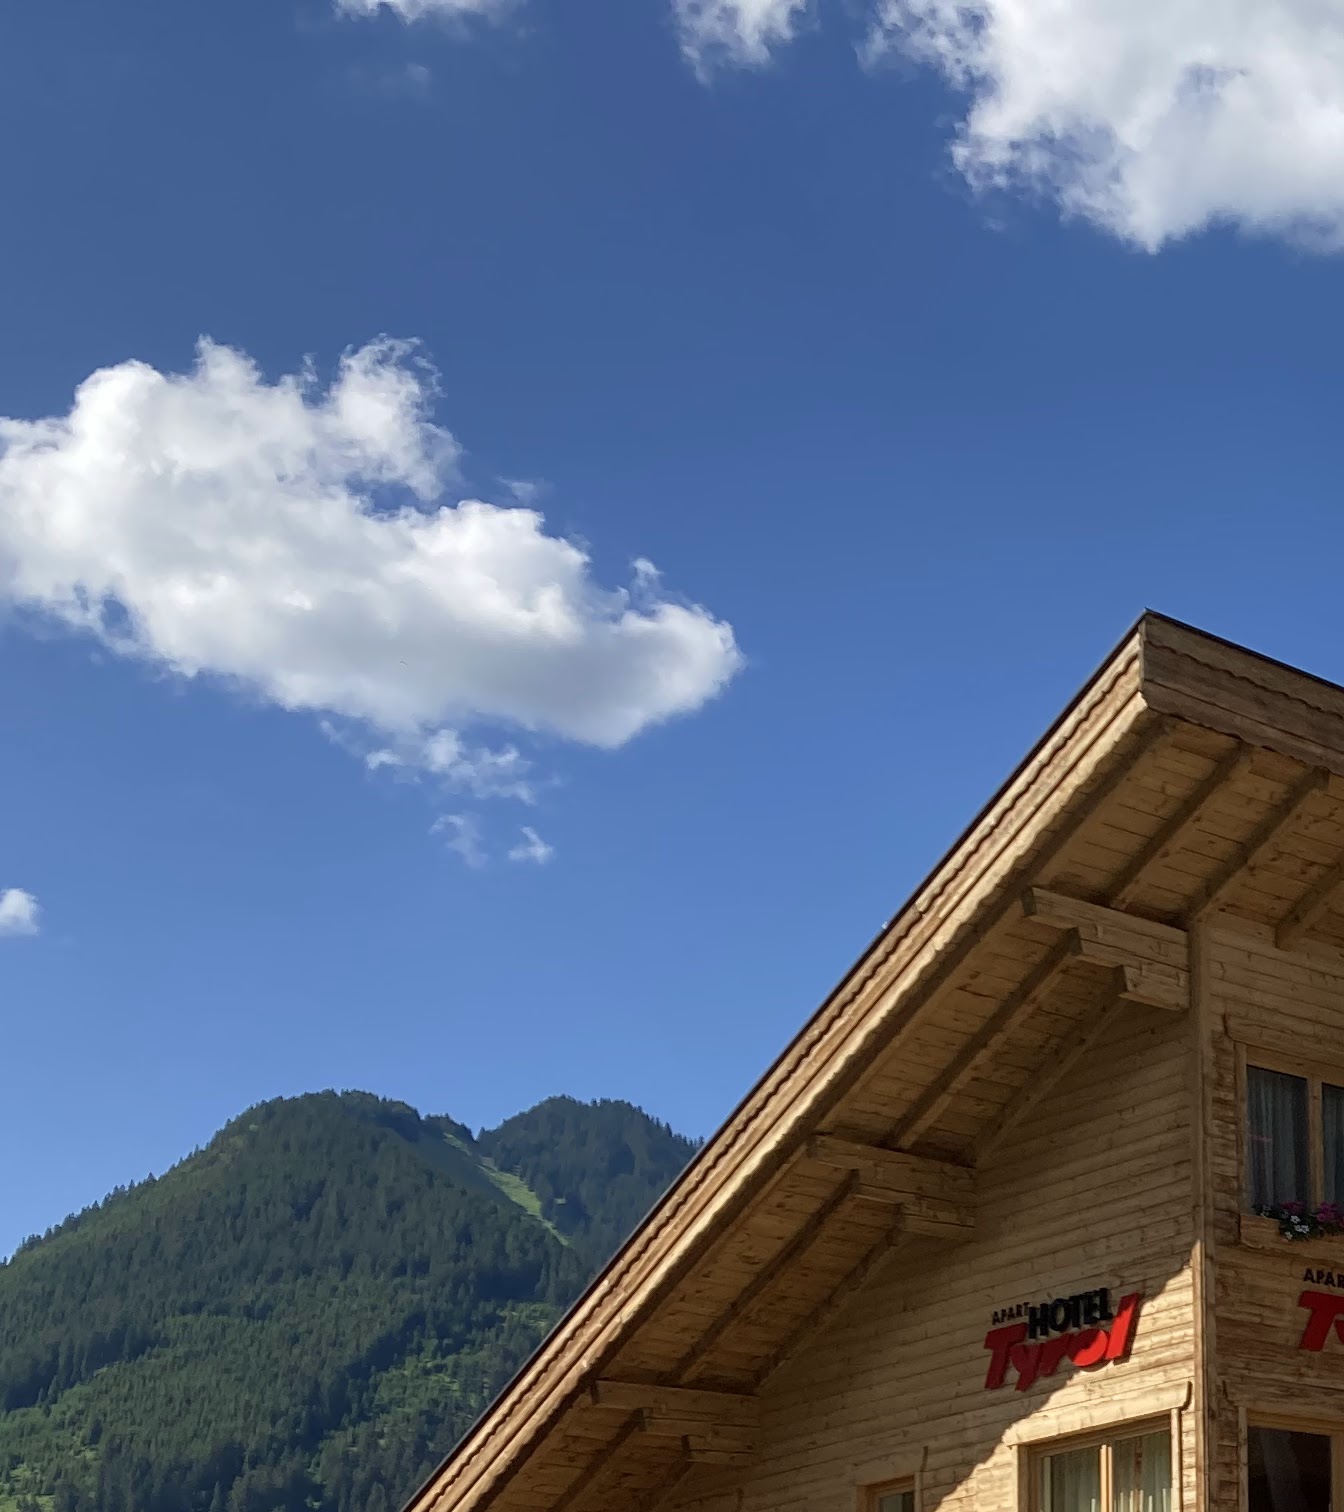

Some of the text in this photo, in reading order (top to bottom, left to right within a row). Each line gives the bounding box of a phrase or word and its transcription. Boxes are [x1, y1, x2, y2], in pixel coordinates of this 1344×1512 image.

[984, 1292, 1140, 1392] Tyrol
[992, 1288, 1113, 1339] APART HOTEL
